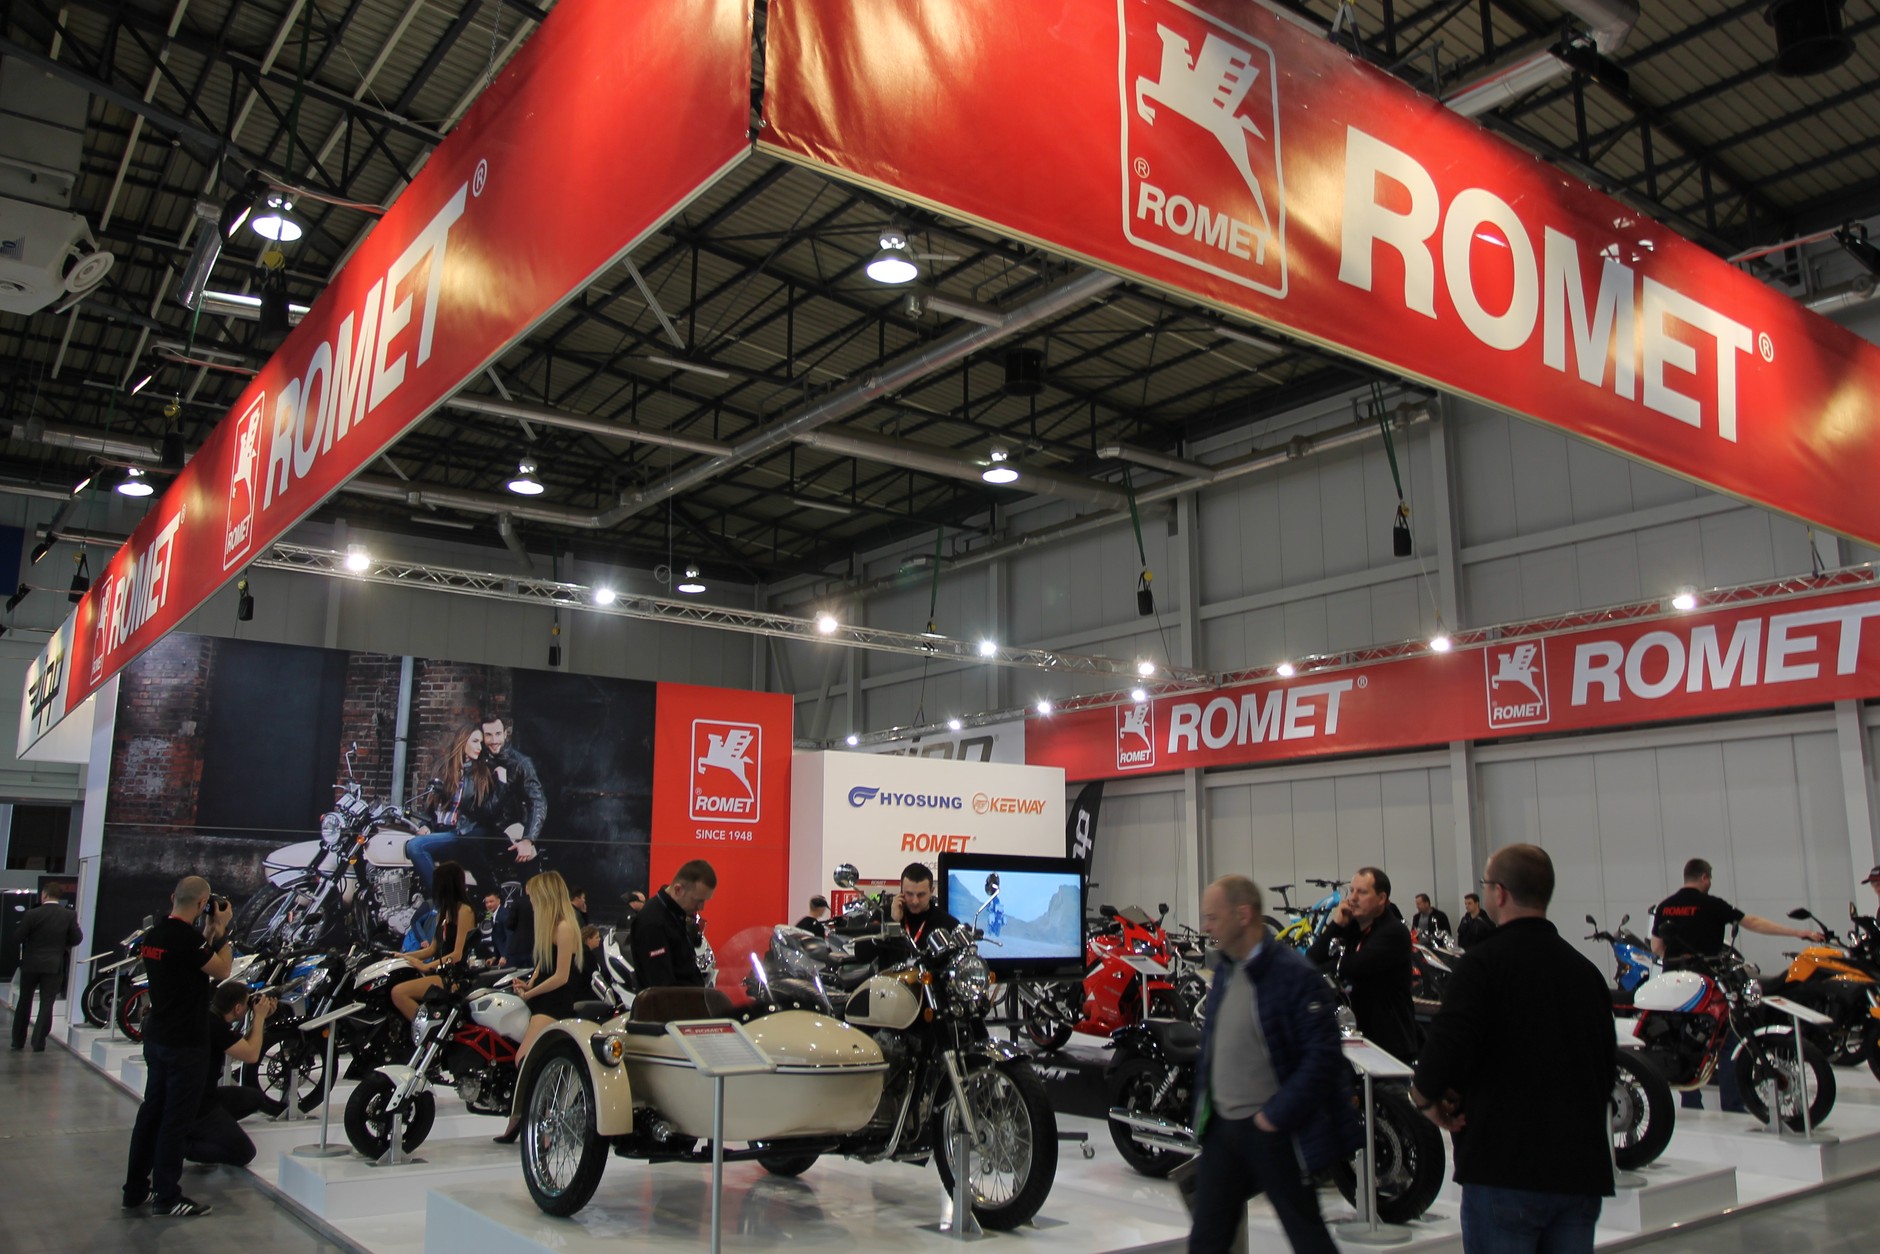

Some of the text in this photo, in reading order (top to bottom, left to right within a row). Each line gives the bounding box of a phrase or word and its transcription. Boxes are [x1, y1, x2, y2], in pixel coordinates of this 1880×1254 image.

[1137, 181, 1270, 266] ROMET
[1337, 124, 1753, 443] ROMET
[263, 181, 468, 511] ROMET
[226, 513, 251, 555] ROMET
[107, 511, 181, 656] ROMET
[1571, 602, 1880, 707] ROMET
[1167, 679, 1353, 754] ROMET
[1493, 703, 1544, 721] ROMET
[1120, 750, 1152, 764] ROMET
[695, 796, 754, 813] ROMET
[880, 792, 963, 810] HYOSUNG
[989, 797, 1046, 815] KEEWAY
[695, 829, 753, 841] SINCE 1948
[901, 833, 971, 853] ROMET
[1663, 906, 1697, 916] ROMET
